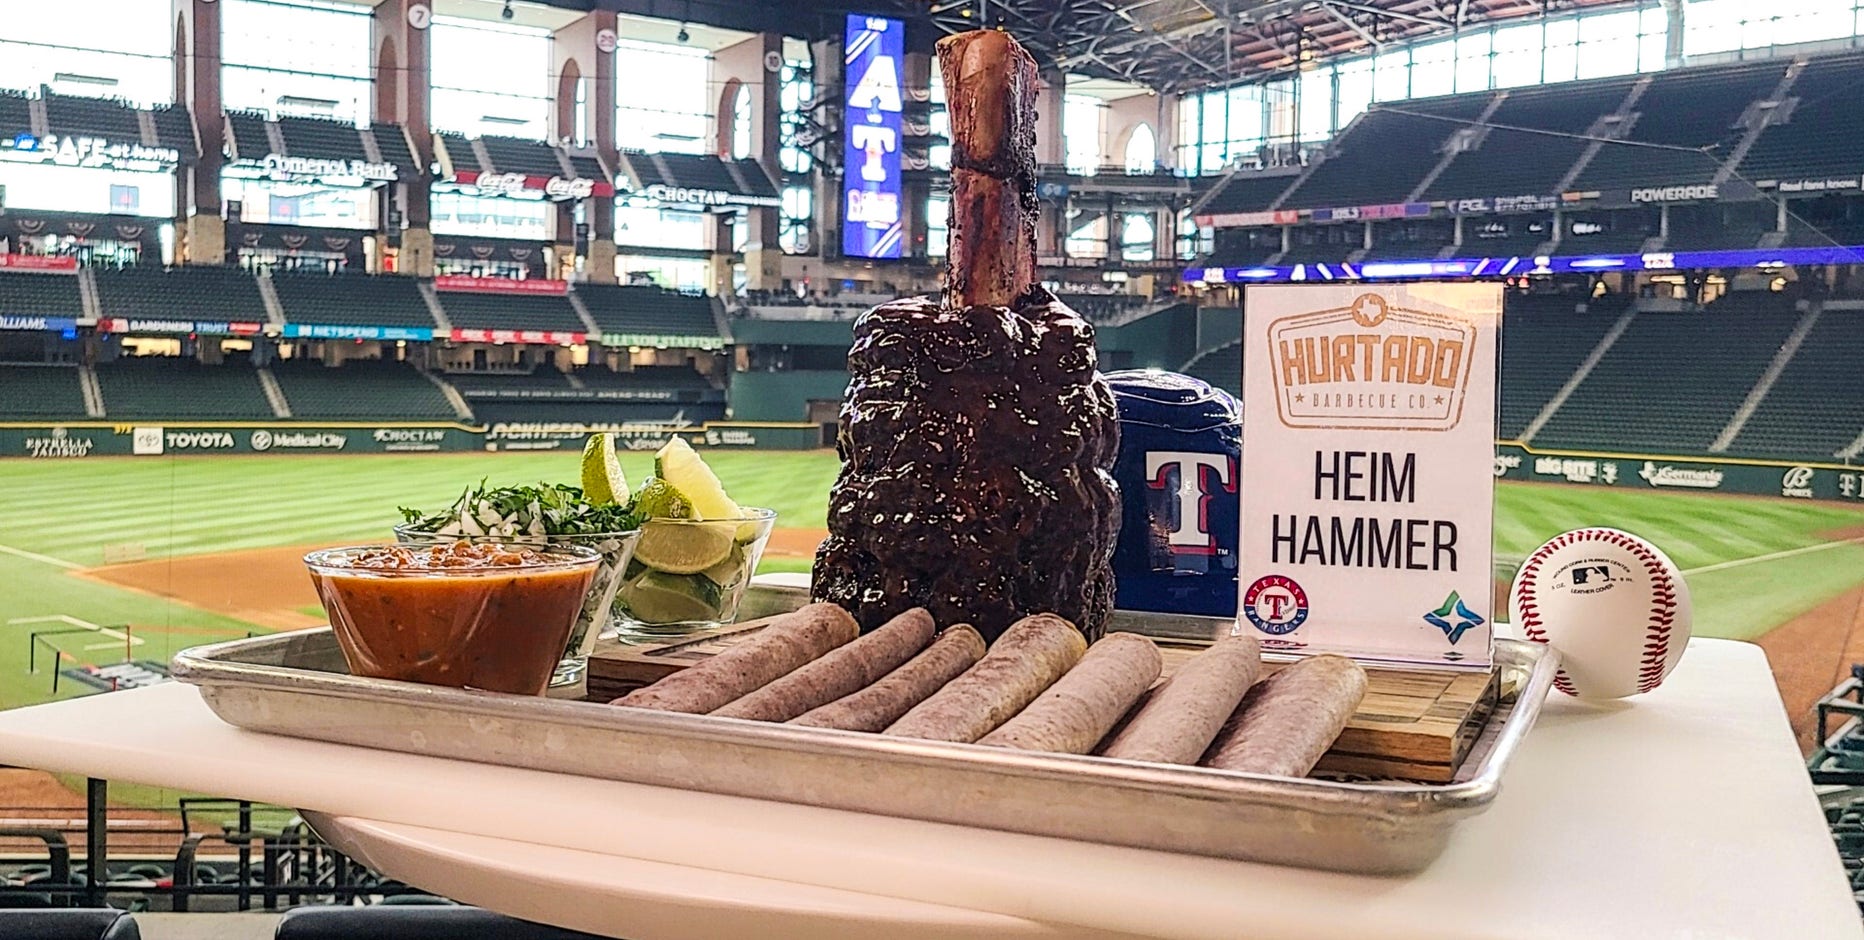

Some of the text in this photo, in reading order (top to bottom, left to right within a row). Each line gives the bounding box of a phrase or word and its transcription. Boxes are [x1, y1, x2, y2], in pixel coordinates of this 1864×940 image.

[417, 10, 425, 23] 7
[352, 159, 398, 181] Bank
[655, 186, 728, 205] CHOCTAW
[1631, 184, 1719, 203] POWERADE
[1279, 334, 1464, 388] HURTADO
[1313, 393, 1430, 409] BARBECUE CO.
[26, 437, 94, 449] ESTRELLA
[166, 432, 235, 448] TOYOTA
[321, 432, 348, 449] City
[32, 445, 88, 458] JALISCO
[1314, 450, 1416, 503] HEIM
[1145, 450, 1238, 556] T
[1271, 514, 1458, 572] HAMMER
[1252, 578, 1300, 595] TEXAS
[1570, 583, 1615, 595] LEATHER COVER
[1264, 594, 1289, 620] T
[1247, 609, 1306, 633] RANGERS
